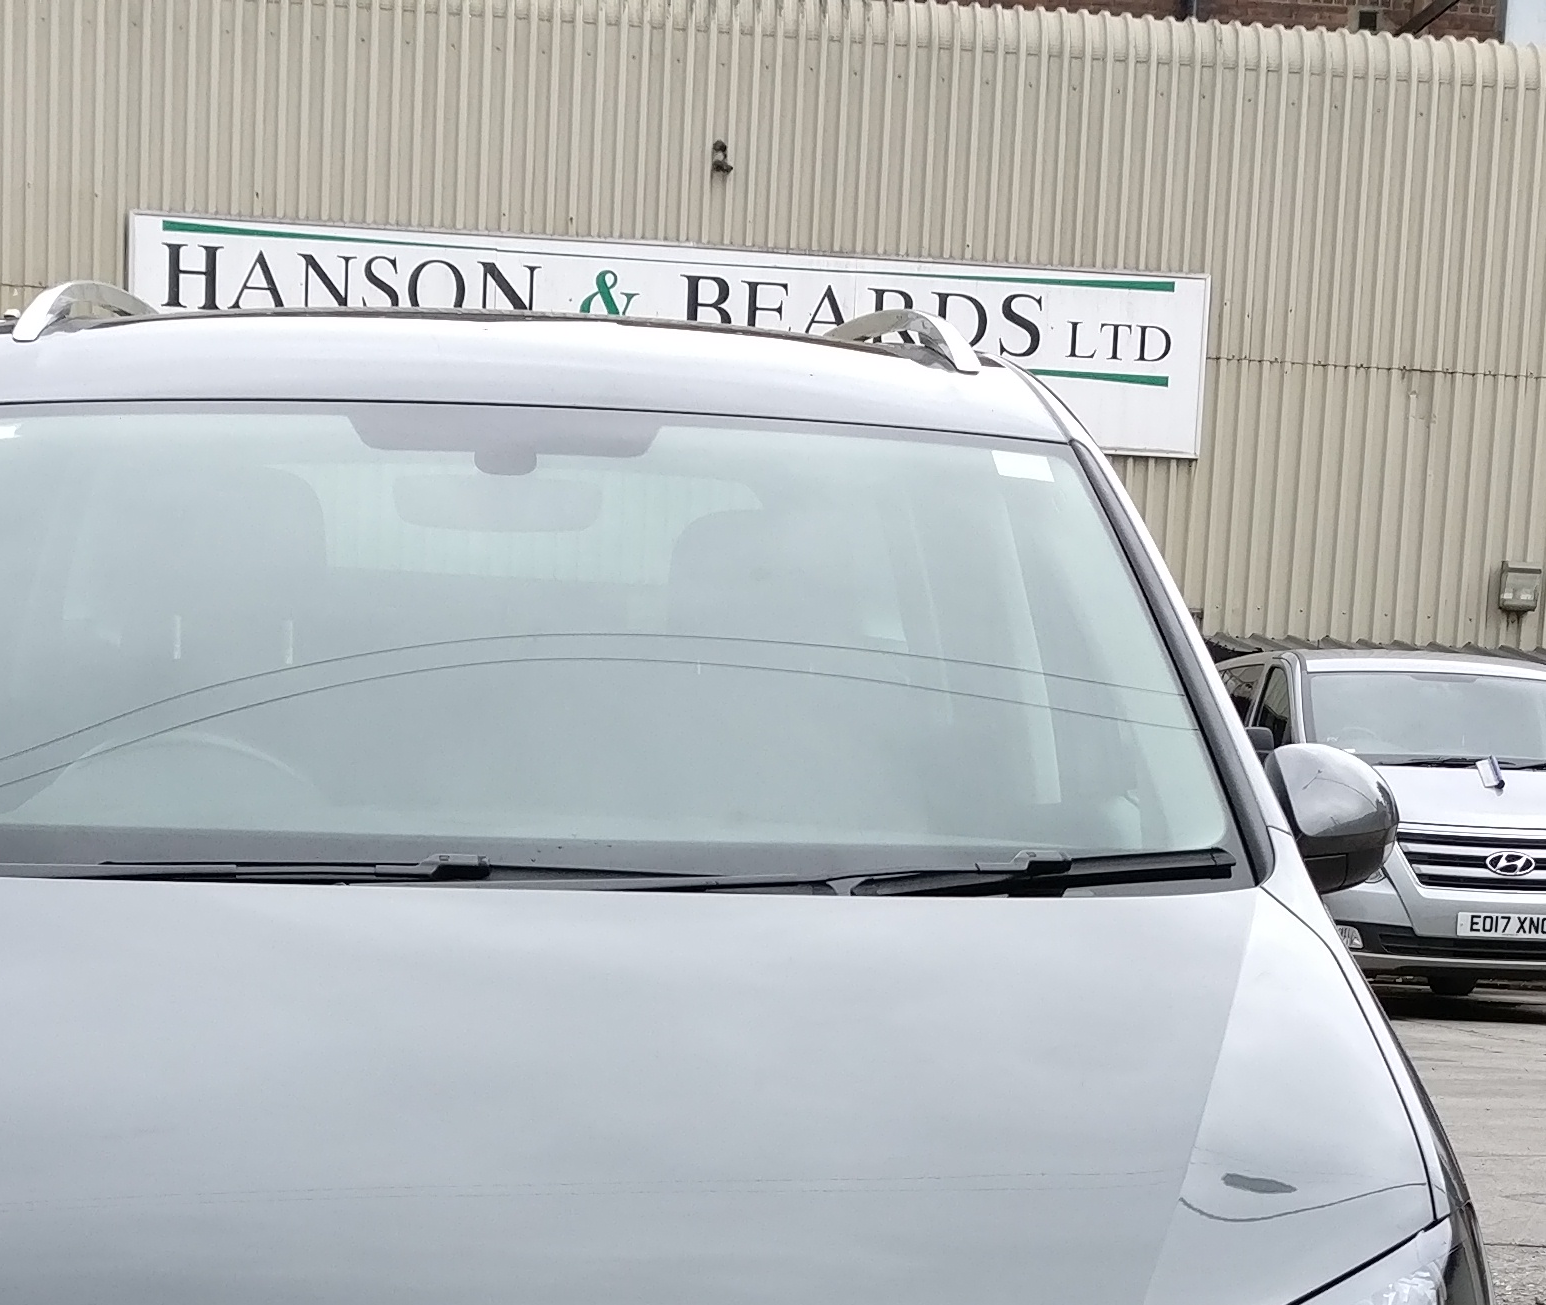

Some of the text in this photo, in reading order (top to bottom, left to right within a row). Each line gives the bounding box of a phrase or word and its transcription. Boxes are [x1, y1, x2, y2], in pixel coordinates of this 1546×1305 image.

[161, 242, 1173, 363] HANSON & BEARDS LTD
[1469, 914, 1511, 933] EO17
